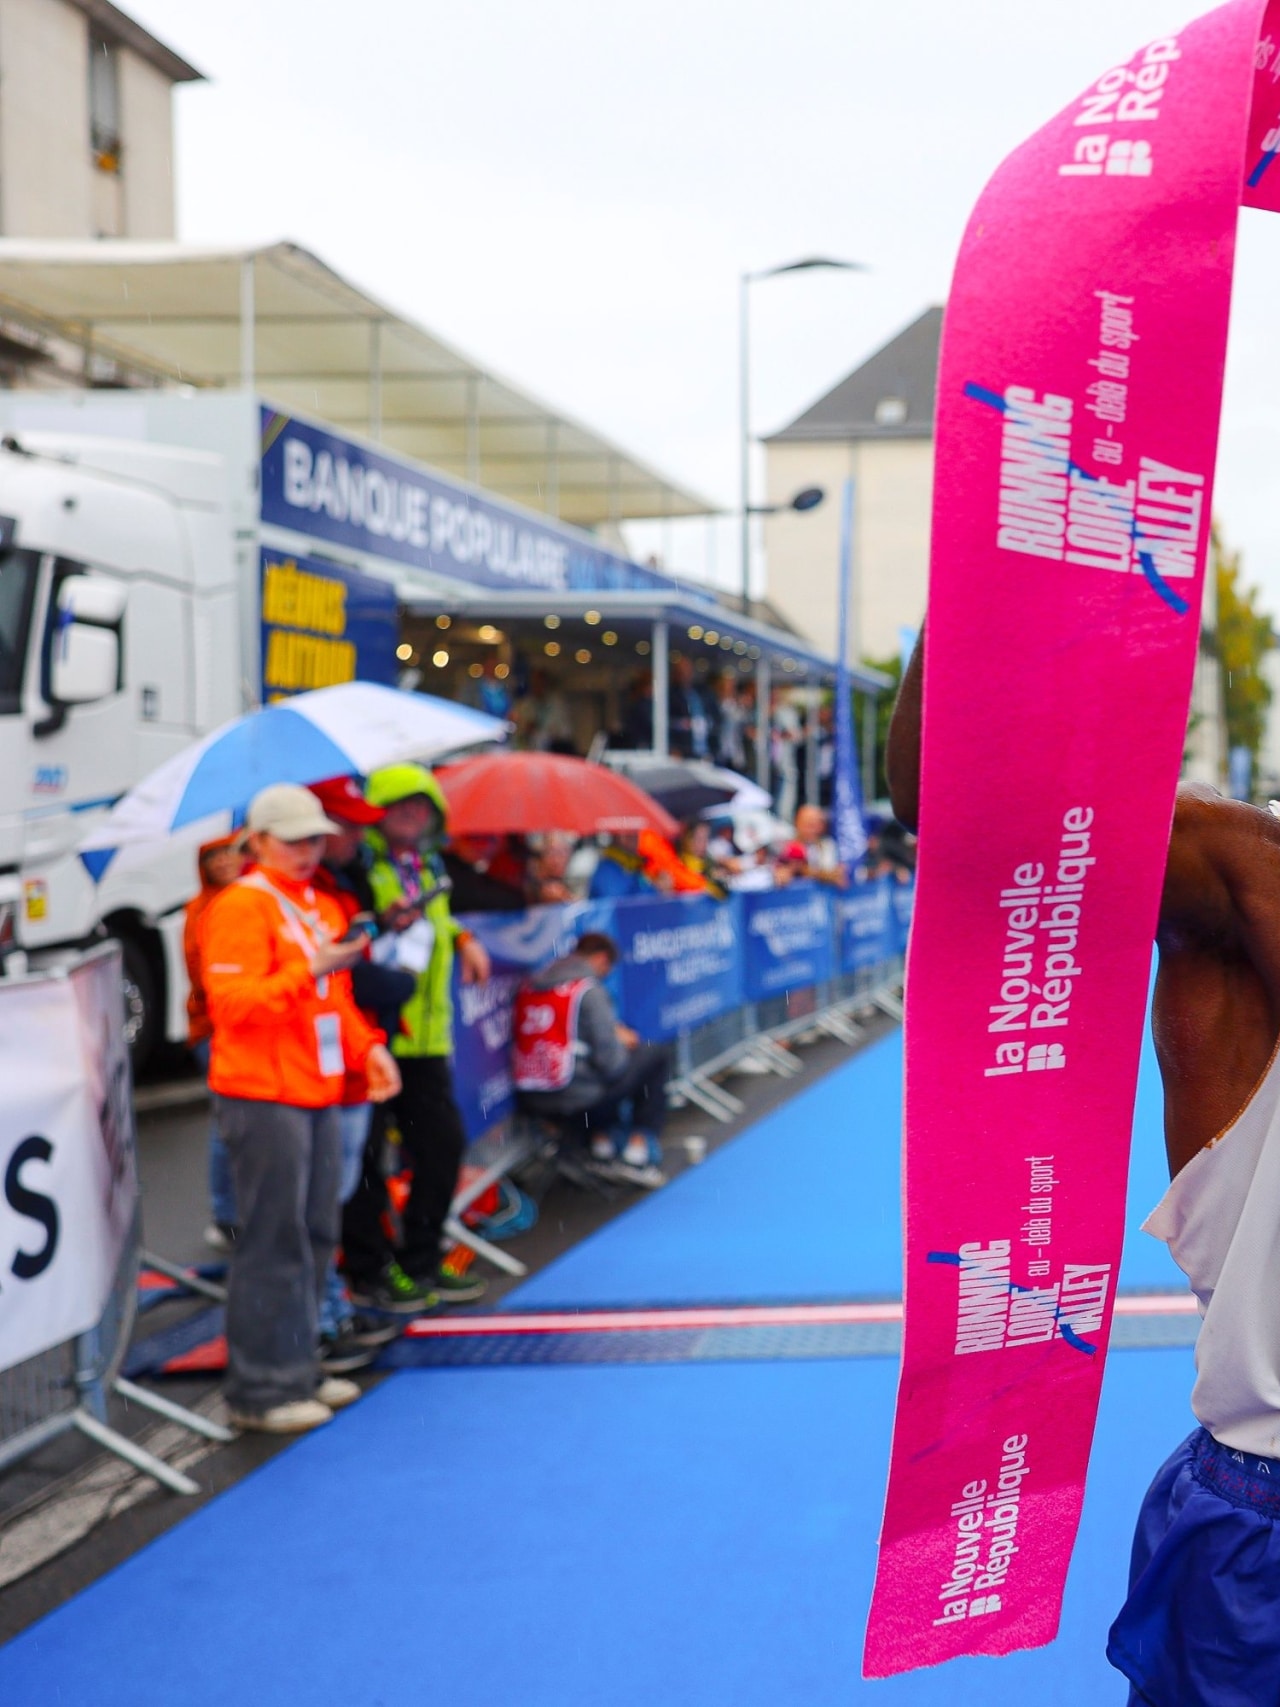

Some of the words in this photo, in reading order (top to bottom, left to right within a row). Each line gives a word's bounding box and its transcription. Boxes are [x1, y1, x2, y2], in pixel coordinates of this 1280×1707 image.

[1058, 133, 1109, 176] la
[1094, 290, 1140, 349] sport
[1087, 352, 1130, 378] du
[997, 385, 1074, 560] RUNNING
[283, 437, 429, 549] BANQUE
[429, 494, 570, 591] POPULAIRE
[1065, 470, 1137, 573] LOIRE
[1131, 457, 1205, 579] VALLEY
[988, 862, 1045, 1033] Nouvelle
[1030, 806, 1097, 1029] République
[984, 1041, 1026, 1077] la
[1023, 1193, 1053, 1214] du
[1024, 1154, 1061, 1193] sport
[1019, 1213, 1052, 1246] delà
[954, 1239, 1012, 1355] RUNNING
[1004, 1281, 1061, 1348] LOIRE
[1055, 1263, 1112, 1339] VALLEY
[940, 1479, 987, 1603] Nouvelle
[977, 1434, 1030, 1587] République
[932, 1599, 968, 1628] la
